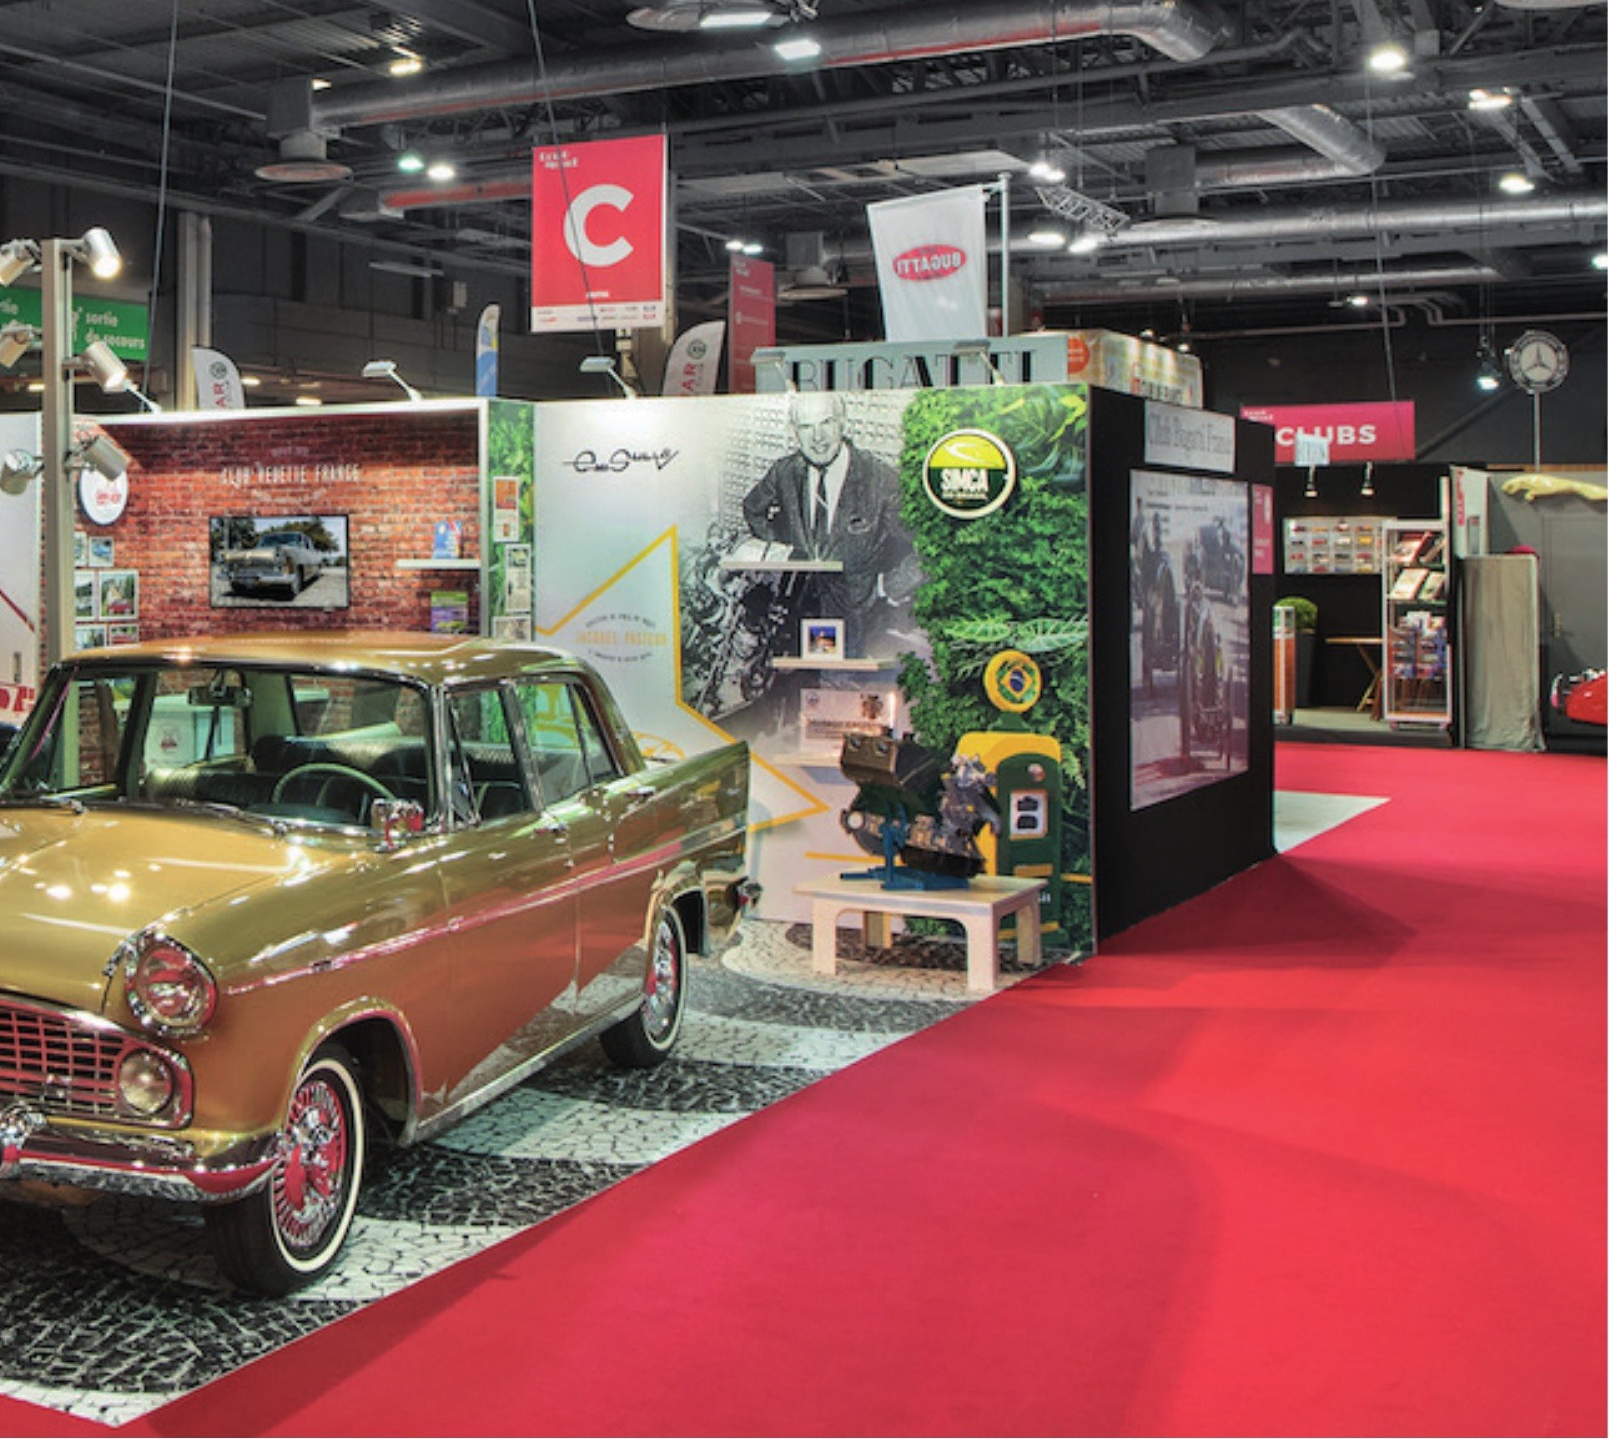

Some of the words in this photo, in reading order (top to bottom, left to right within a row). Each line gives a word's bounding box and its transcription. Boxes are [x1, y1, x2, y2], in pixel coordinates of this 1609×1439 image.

[563, 184, 634, 267] C
[86, 310, 118, 328] sortie
[940, 468, 989, 493] SIMCA
